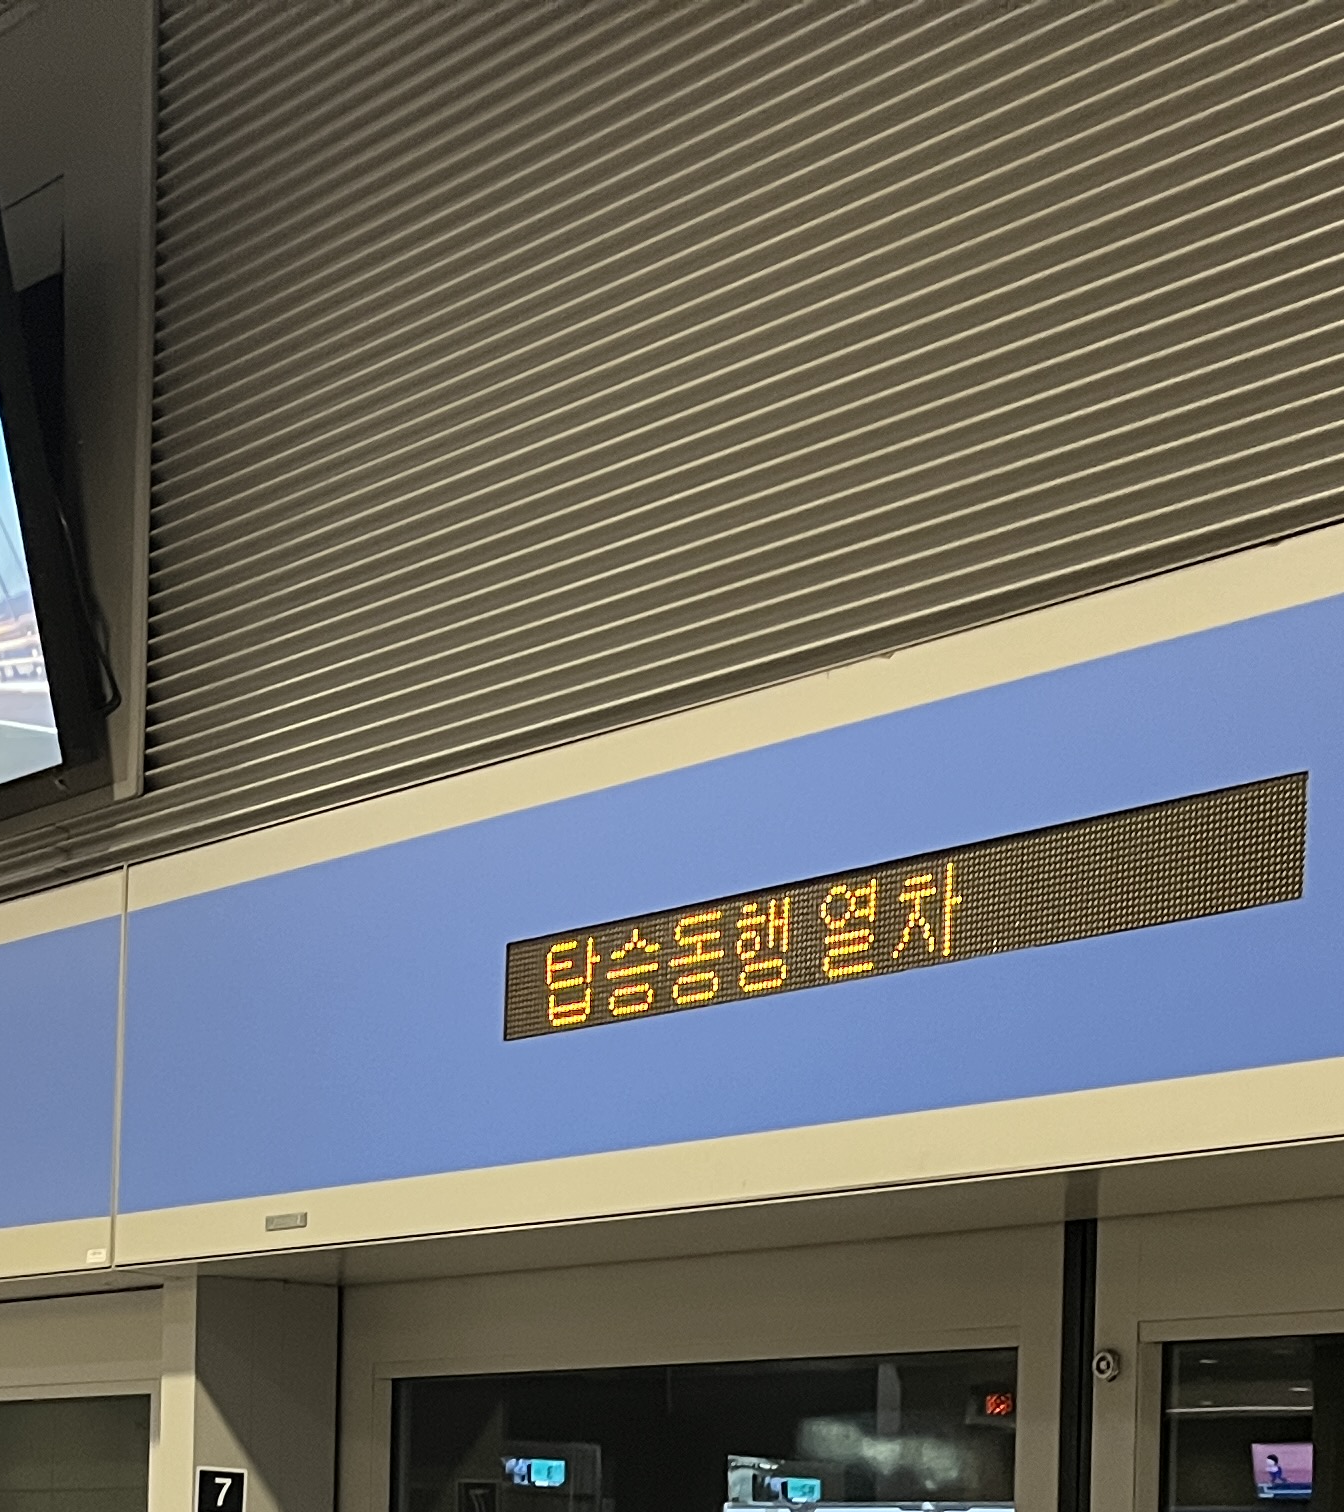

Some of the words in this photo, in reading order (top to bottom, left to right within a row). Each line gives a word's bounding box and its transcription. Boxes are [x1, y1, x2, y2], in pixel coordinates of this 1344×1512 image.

[546, 895, 791, 1027] 탑승동행
[819, 862, 963, 979] 열차
[214, 1476, 232, 1507] 7
